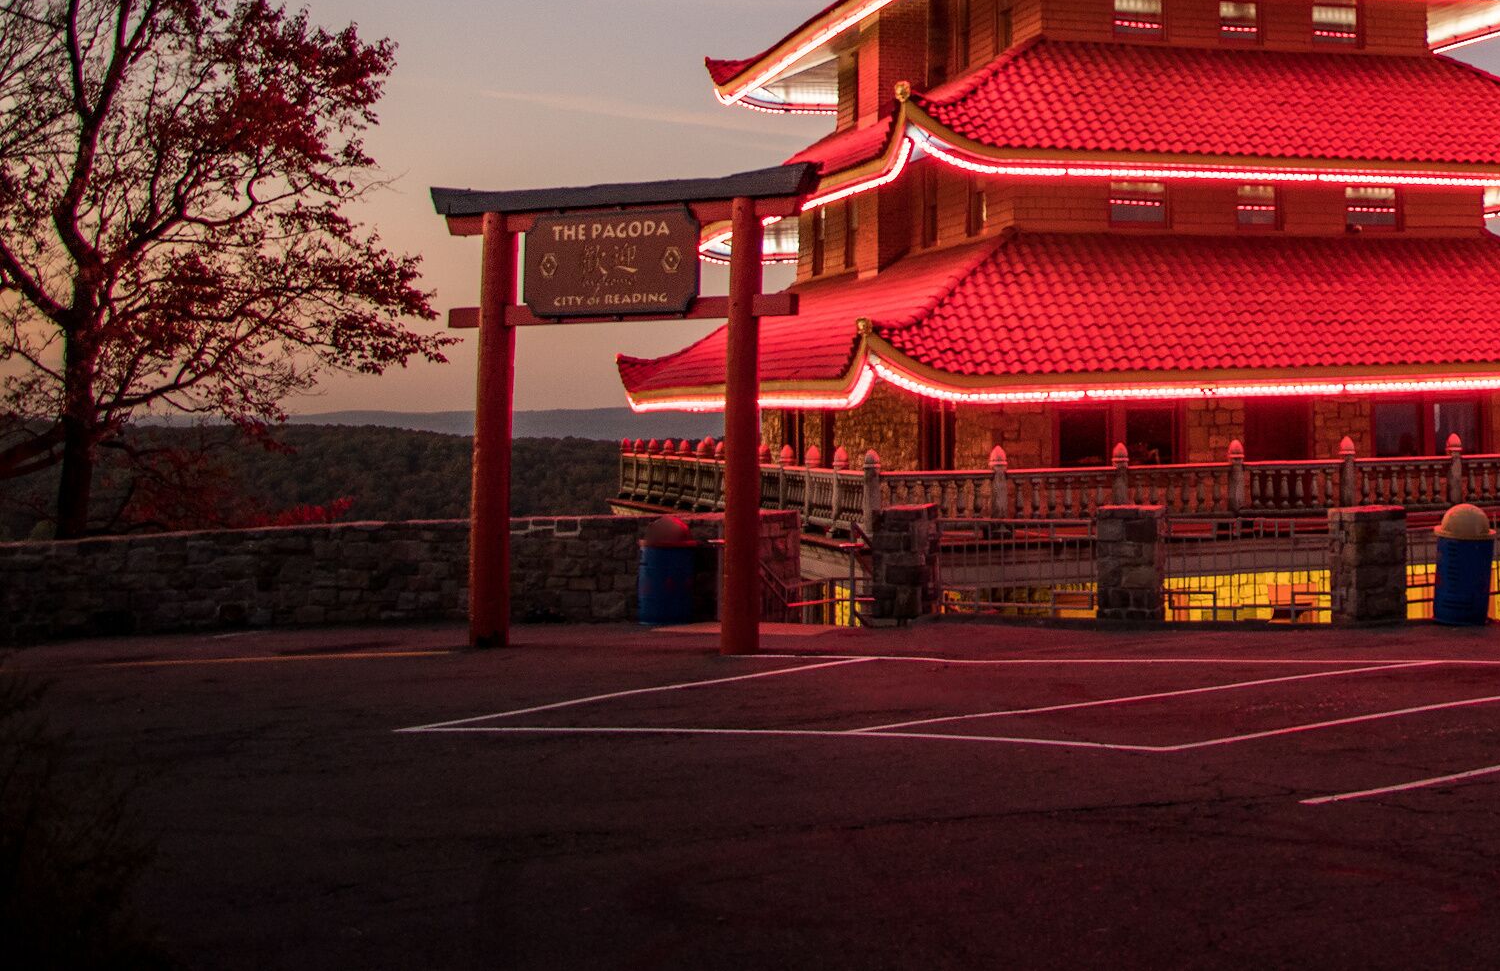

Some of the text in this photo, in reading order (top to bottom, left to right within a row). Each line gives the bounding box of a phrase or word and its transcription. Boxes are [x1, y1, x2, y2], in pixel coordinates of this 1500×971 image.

[552, 220, 670, 241] THE PAGODA
[553, 295, 584, 306] CITY
[604, 292, 668, 305] READING
